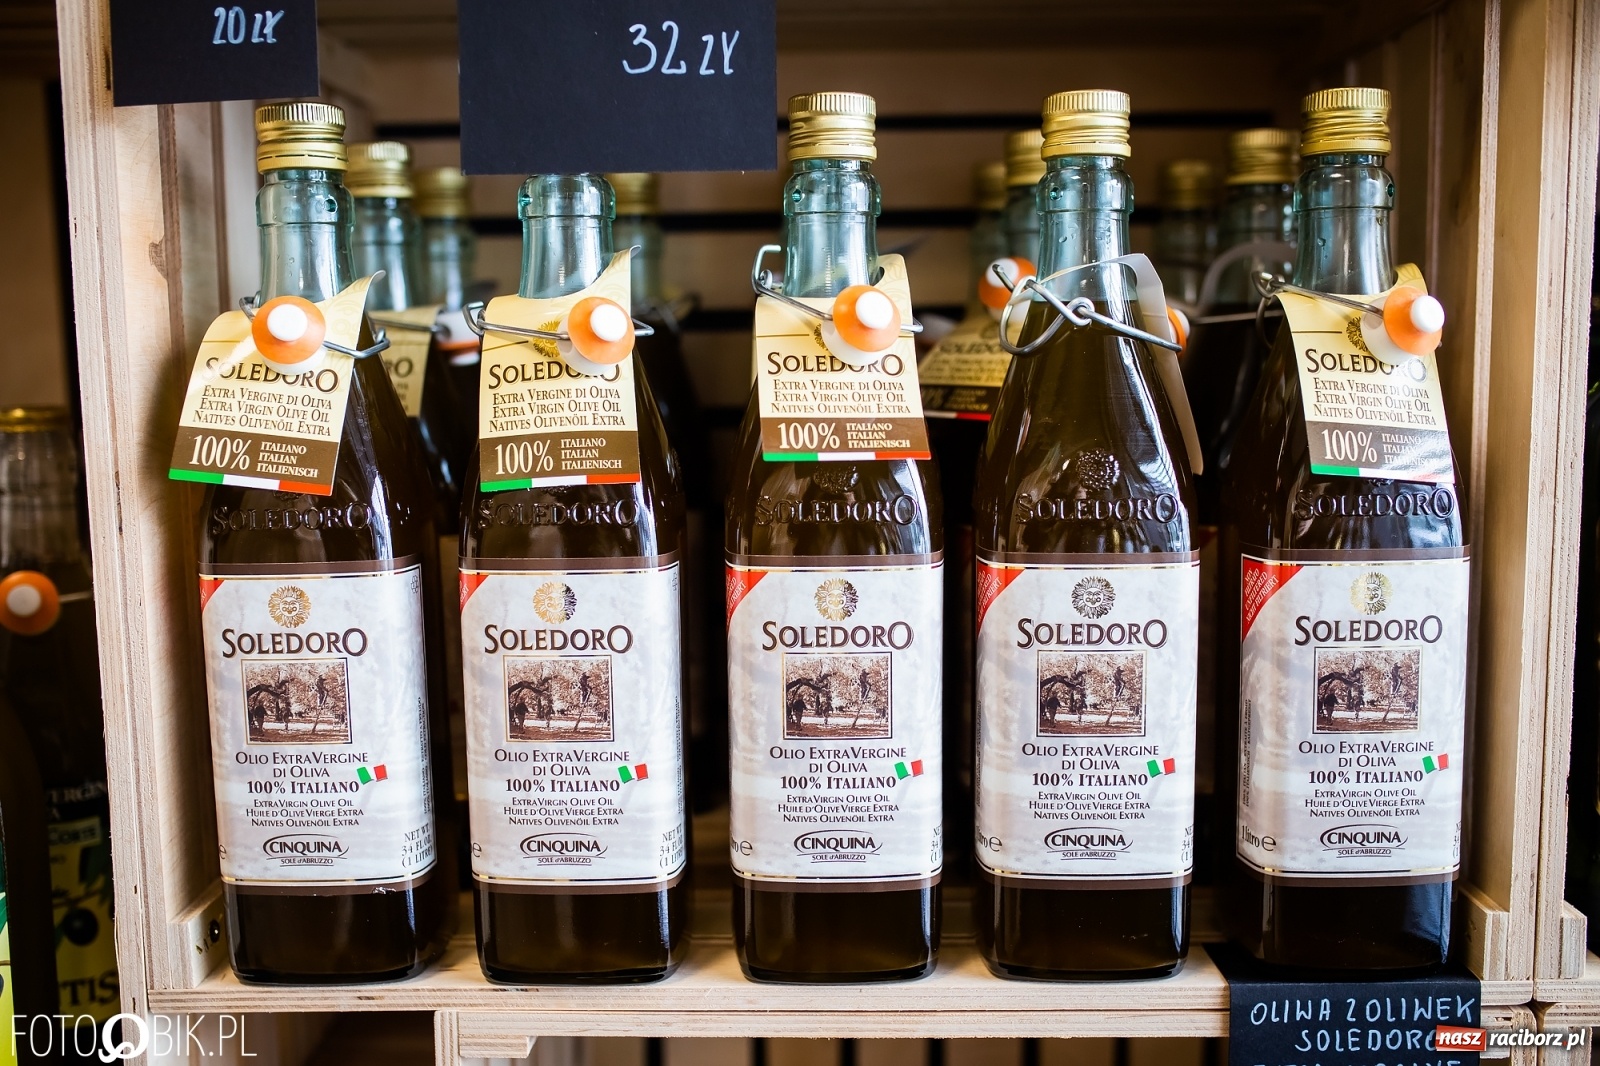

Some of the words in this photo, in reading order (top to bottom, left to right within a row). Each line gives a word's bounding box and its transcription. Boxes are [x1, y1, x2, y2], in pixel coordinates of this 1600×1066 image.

[213, 6, 246, 45] 20
[622, 20, 687, 74] 32
[774, 379, 807, 391] EXTRA
[810, 380, 855, 391] VERGINE
[873, 380, 904, 391] OLIVA
[1314, 377, 1345, 392] EXTRA
[1347, 380, 1387, 394] VERGINE
[1402, 385, 1429, 399] OLIVA
[202, 385, 235, 399] EXTRA
[240, 388, 283, 403] VERGINE
[301, 394, 332, 409] OLIVA
[493, 393, 525, 405] EXTRA
[528, 388, 572, 401] VERGINE
[589, 386, 620, 399] OLIVA
[774, 391, 808, 402] EXTRA
[811, 391, 848, 402] VIRGIN
[851, 391, 883, 402] OLIVE
[886, 392, 906, 403] OIL
[1315, 391, 1347, 405] EXTRA
[1349, 393, 1382, 407] VIRGIN
[1385, 396, 1412, 411] OLIVE
[1415, 399, 1431, 412] OIL
[199, 398, 232, 412] EXTRA
[237, 400, 273, 415] VIRGIN
[276, 405, 308, 420] OLIVE
[311, 409, 330, 423] OIL
[493, 406, 525, 418] EXTRA
[529, 402, 565, 414] VIRGIN
[568, 400, 599, 413] OLIVE
[602, 400, 621, 413] OIL
[771, 402, 814, 414] NATIVES
[817, 402, 874, 414] OLIVENÖIL
[877, 403, 911, 414] EXTRA
[1314, 404, 1353, 418] NATIVES
[1356, 407, 1405, 423] OLIVENÖIL
[1407, 411, 1436, 426] EXTRA
[193, 410, 235, 426] NATIVES
[239, 414, 293, 432] OLIVENÖIL
[297, 421, 331, 436] EXTRA
[489, 419, 531, 432] NATIVES
[534, 415, 589, 428] OLIVENÖIL
[592, 413, 626, 426] EXTRA
[847, 423, 892, 431] ITALIANO
[777, 422, 840, 449] 100%
[847, 431, 886, 440] ITALIAN
[260, 441, 307, 455] ITALIANO
[561, 438, 606, 448] ITALIANO
[848, 440, 910, 448] ITALIENISCH
[1321, 429, 1377, 463] 100%
[189, 434, 251, 470] 100%
[258, 452, 297, 464] ITALIAN
[495, 440, 553, 475] 100%
[561, 449, 599, 459] ITALIAN
[256, 463, 318, 478] ITALIENISCH
[561, 460, 622, 470] ITALIENISCH
[754, 494, 917, 526] SOLEDORO
[1016, 492, 1179, 524] SOLEDORO
[1294, 487, 1454, 519] SOLEDORO
[213, 501, 371, 533] SOLEDORO
[478, 498, 639, 530] SOLEDORO
[762, 621, 913, 650] SOLEDORO
[1017, 618, 1168, 648] SOLEDORO
[1295, 615, 1442, 645] SOLEDORO
[222, 628, 368, 658] SOLEDORO
[485, 624, 633, 654] SOLEDORO
[770, 746, 805, 759] OLIO
[1022, 743, 1058, 756] OLIO
[1299, 741, 1334, 754] OLIO
[236, 752, 268, 764] OLIO
[495, 749, 528, 762] OLIO
[1357, 755, 1396, 767] OLIVA
[550, 764, 590, 776] OLIVA
[827, 761, 868, 773] OLIVA
[1080, 758, 1120, 770] OLIVA
[290, 766, 330, 777] OLIVA
[1309, 771, 1350, 784] 100%
[1355, 771, 1423, 783] ITALIANO
[506, 779, 545, 792] 100%
[551, 780, 620, 792] ITALIANO
[781, 776, 821, 789] 100%
[827, 776, 896, 789] ITALIANO
[1032, 773, 1074, 786] 100%
[1079, 774, 1148, 786] ITALIANO
[248, 781, 286, 794] 100%
[291, 781, 359, 793] ITALIANO
[778, 804, 803, 813] HUILE
[873, 804, 899, 812] EXTRA
[1310, 809, 1344, 817] NATIVES
[1347, 808, 1393, 817] OLIVENÖIL
[1395, 808, 1420, 816] EXTRA
[252, 818, 283, 827] NATIVES
[286, 818, 331, 827] OLIVENÖIL
[333, 818, 359, 826] EXTRA
[404, 829, 420, 842] NET
[1051, 834, 1126, 849] CINQUINA
[1327, 831, 1401, 846] CINQUINA
[269, 841, 342, 855] CINQUINA
[402, 843, 413, 856] 34
[527, 840, 601, 854] CINQUINA
[801, 837, 876, 851] CINQUINA
[1250, 998, 1331, 1025] OLIWA
[1365, 995, 1475, 1023] OLIWEK
